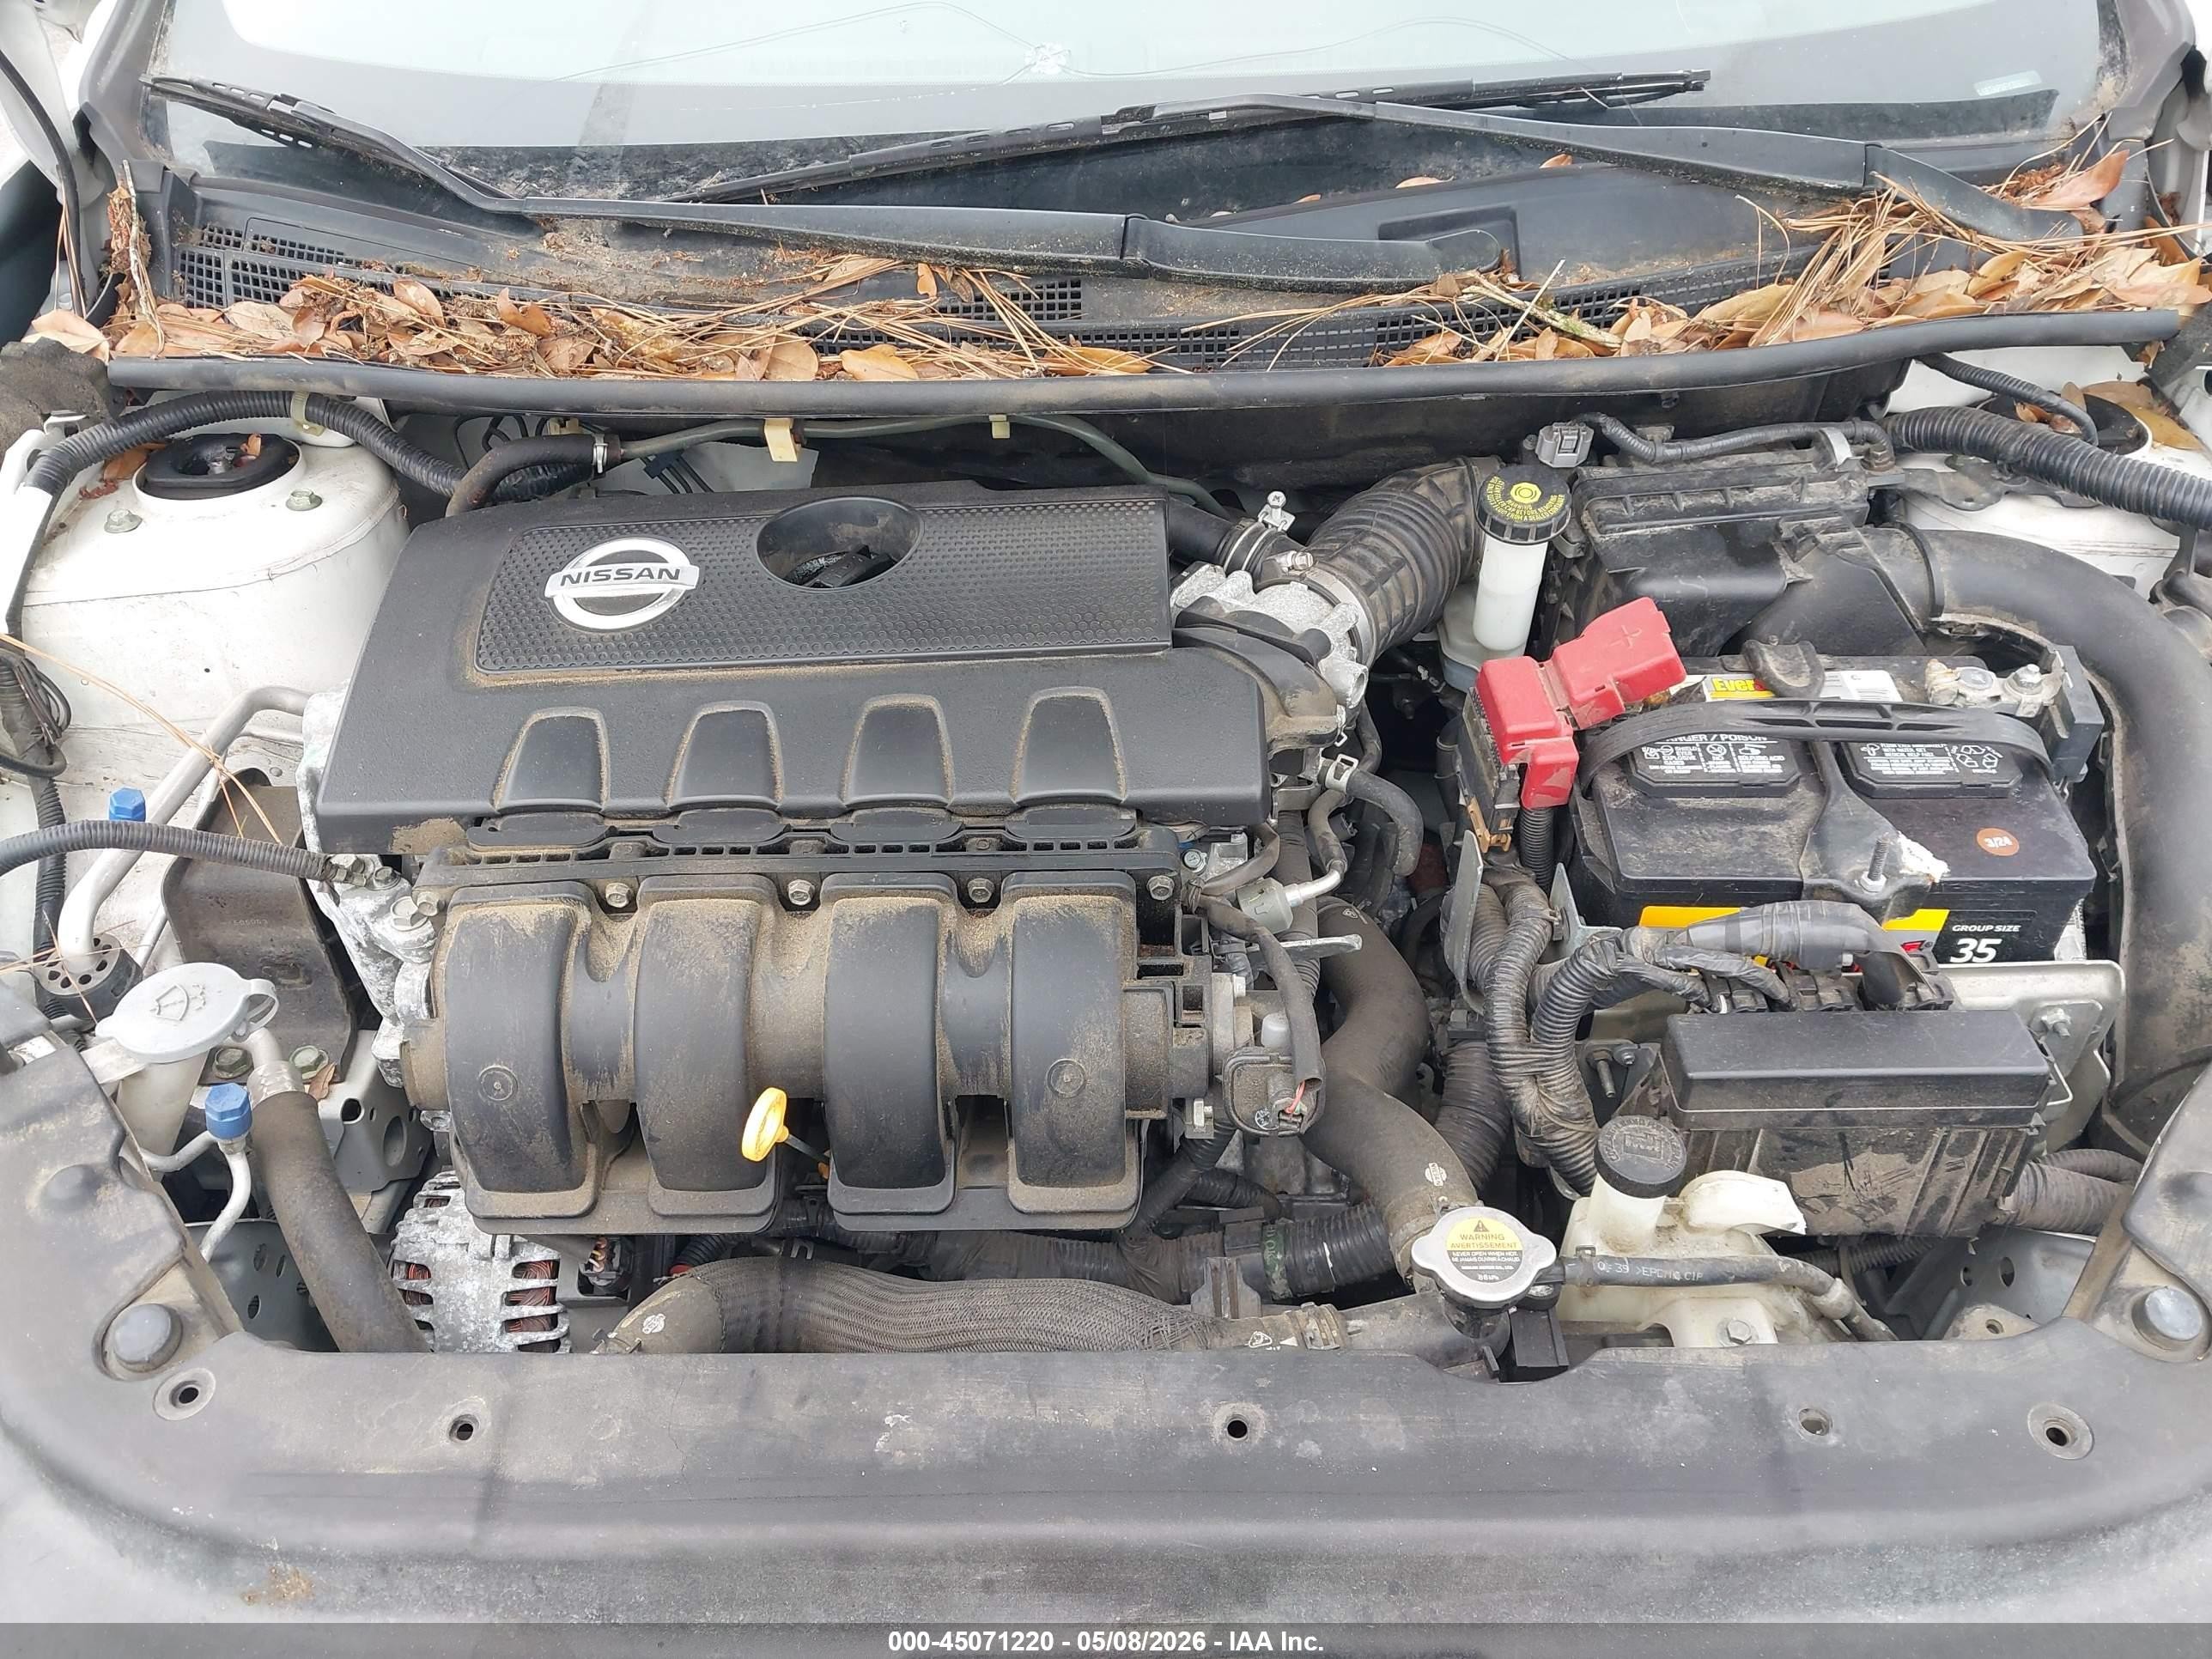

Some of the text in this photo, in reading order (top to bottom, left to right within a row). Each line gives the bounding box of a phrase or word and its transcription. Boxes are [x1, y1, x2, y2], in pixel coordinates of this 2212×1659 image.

[1505, 500, 1532, 510] WARNING
[561, 568, 680, 586] NISSAN
[1984, 836, 2013, 848] 3/24
[1950, 939, 2002, 963] 35
